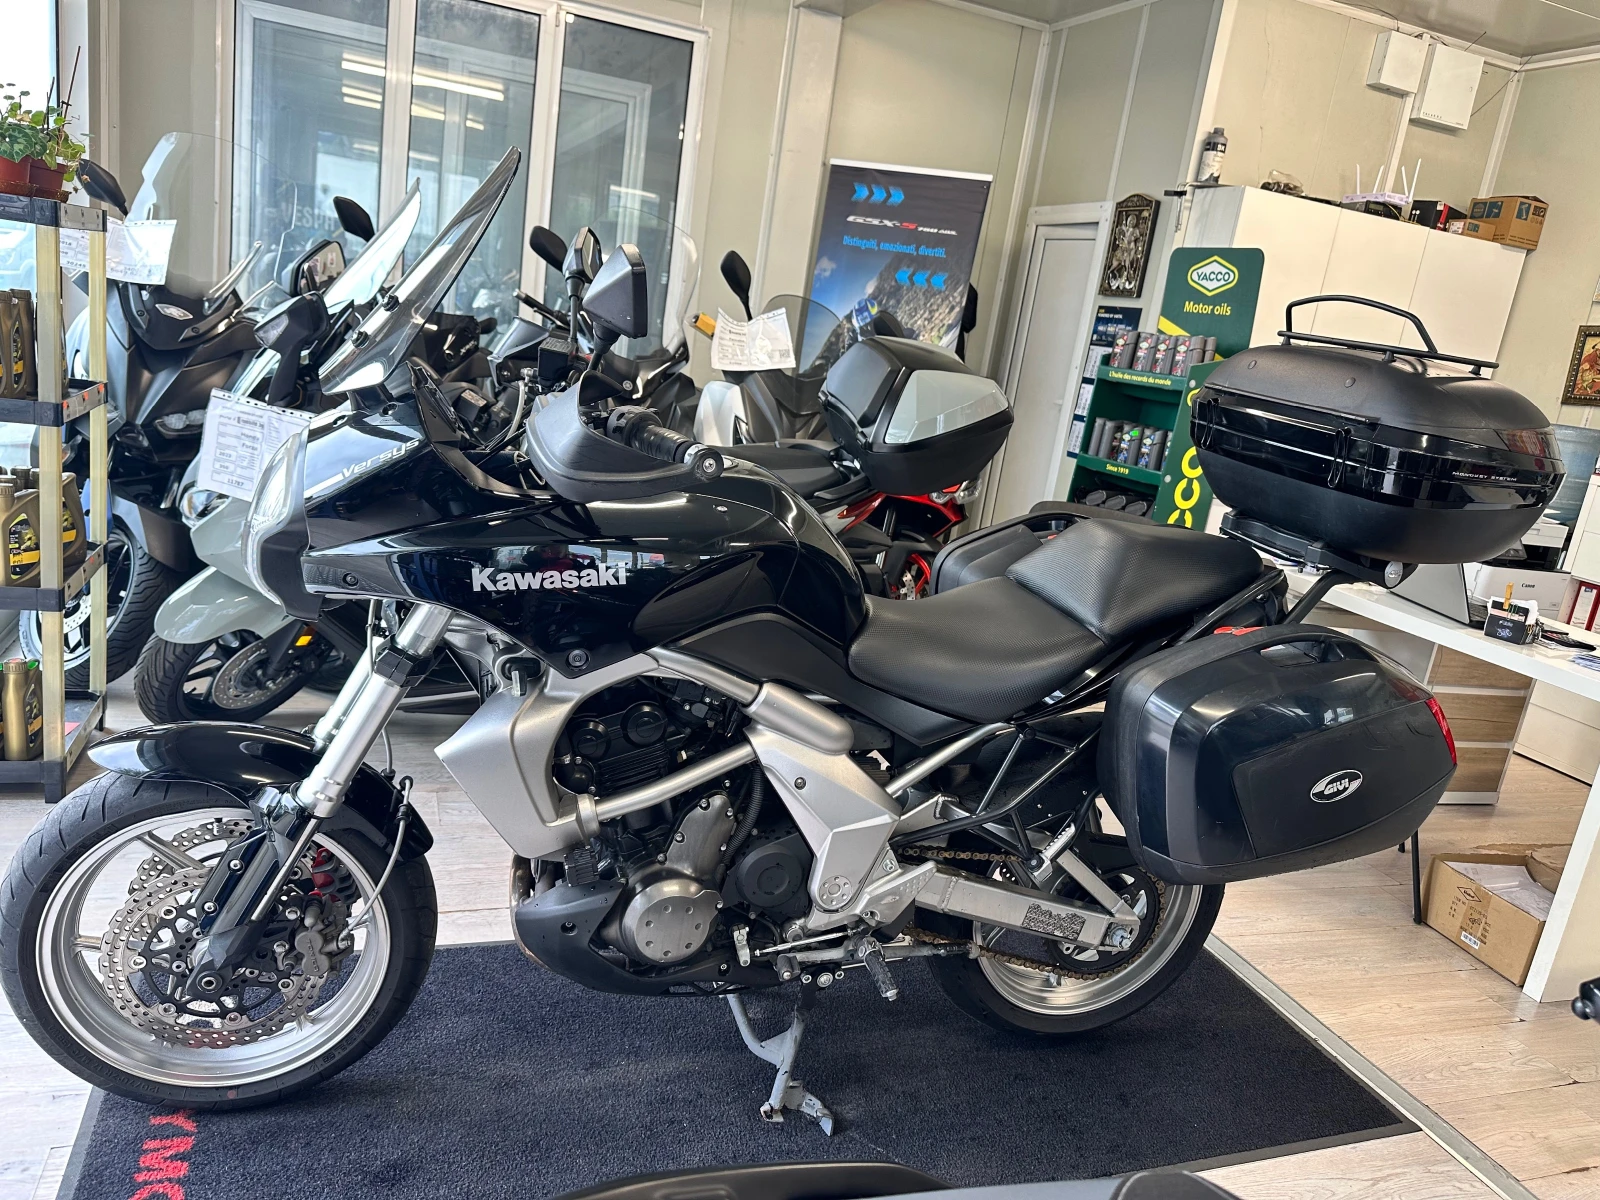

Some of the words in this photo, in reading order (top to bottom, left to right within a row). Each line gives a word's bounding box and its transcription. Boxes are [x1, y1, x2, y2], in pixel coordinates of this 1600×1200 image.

[918, 247, 947, 258] divertiti.
[1196, 271, 1231, 282] YACCO
[1183, 300, 1213, 314] Motor
[1213, 303, 1231, 316] oils
[1109, 370, 1123, 380] L'huile
[1123, 373, 1131, 381] des
[1131, 375, 1148, 383] records
[1147, 376, 1155, 384] du
[1154, 378, 1172, 386] monde
[342, 437, 420, 478] Versys
[1106, 463, 1118, 473] Since
[1117, 465, 1129, 475] 1919
[471, 562, 628, 592] Kawasaki
[1323, 778, 1350, 795] GIVI
